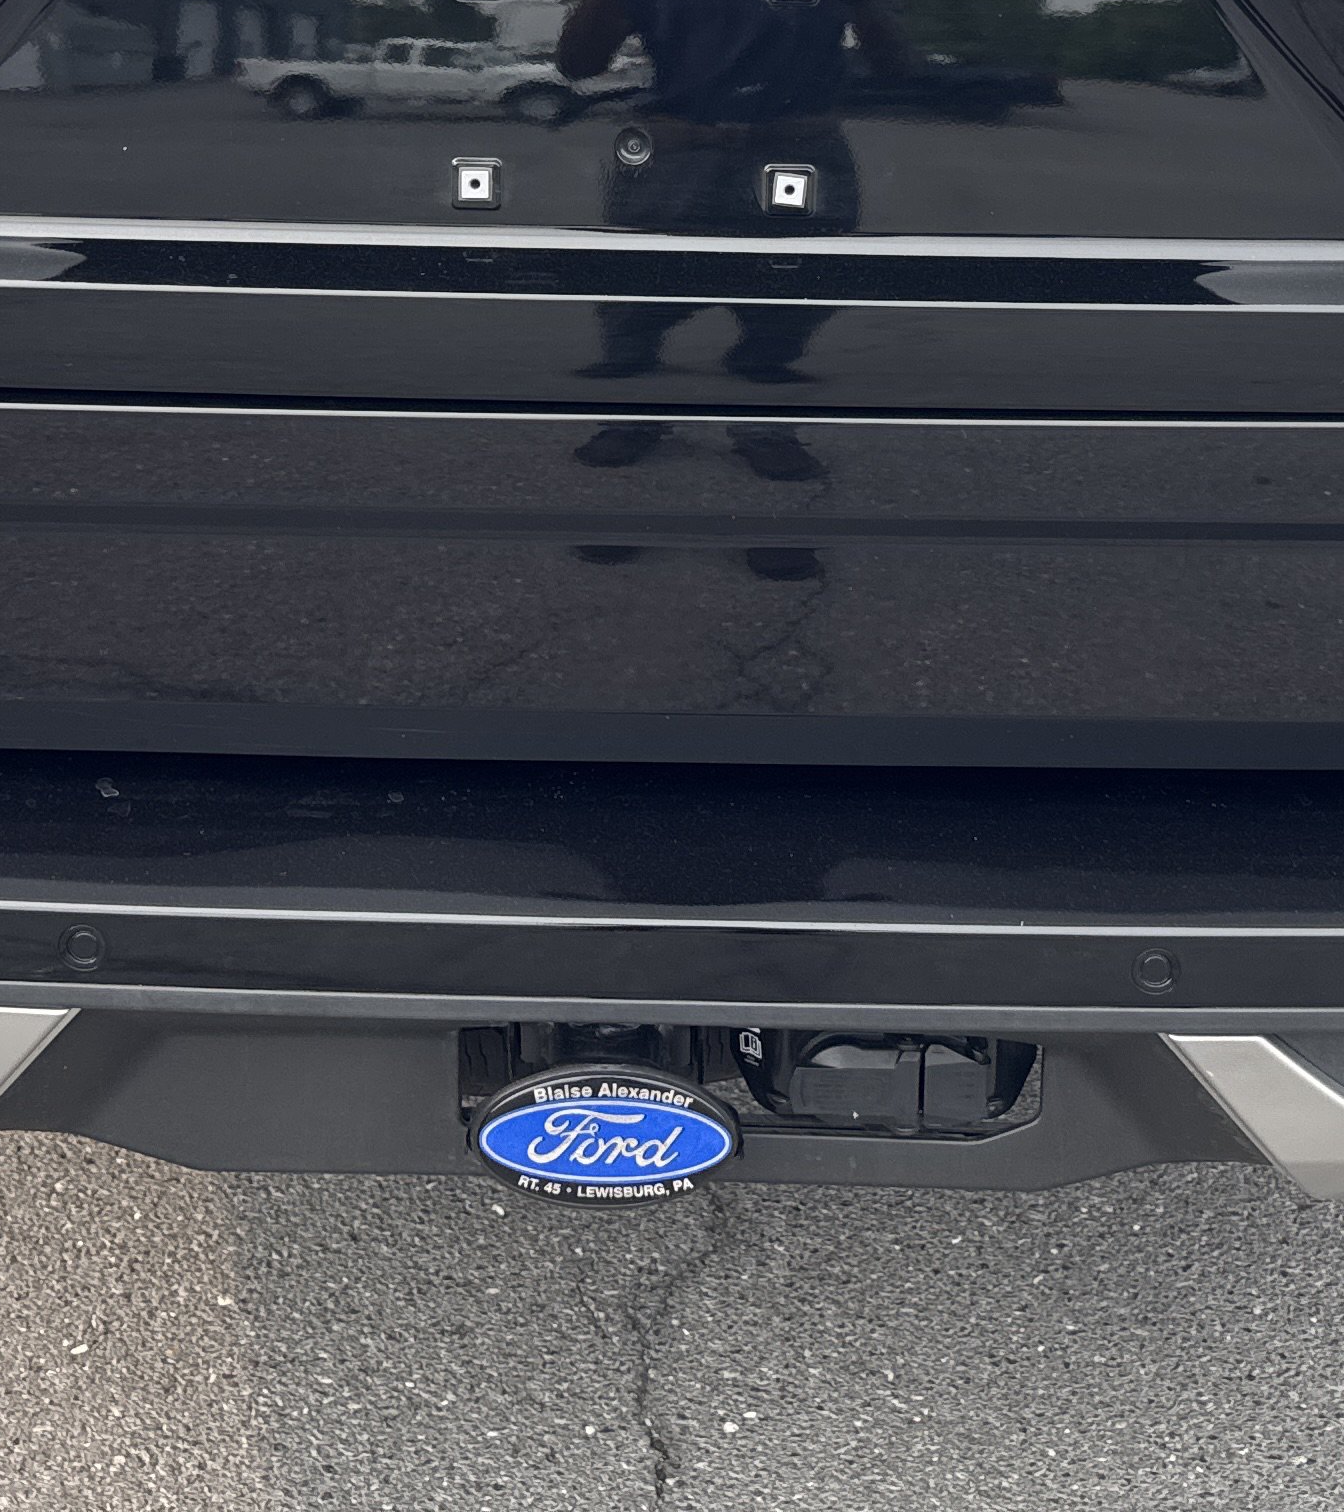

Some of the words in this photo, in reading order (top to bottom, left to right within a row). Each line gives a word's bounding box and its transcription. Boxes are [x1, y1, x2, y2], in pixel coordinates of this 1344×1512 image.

[533, 1084, 593, 1104] Blaise
[597, 1082, 694, 1109] Alexander
[527, 1108, 684, 1168] Ford
[517, 1174, 540, 1192] RT.
[543, 1181, 562, 1196] 45
[576, 1184, 670, 1199] LEWISBURG,
[672, 1177, 695, 1192] PA
